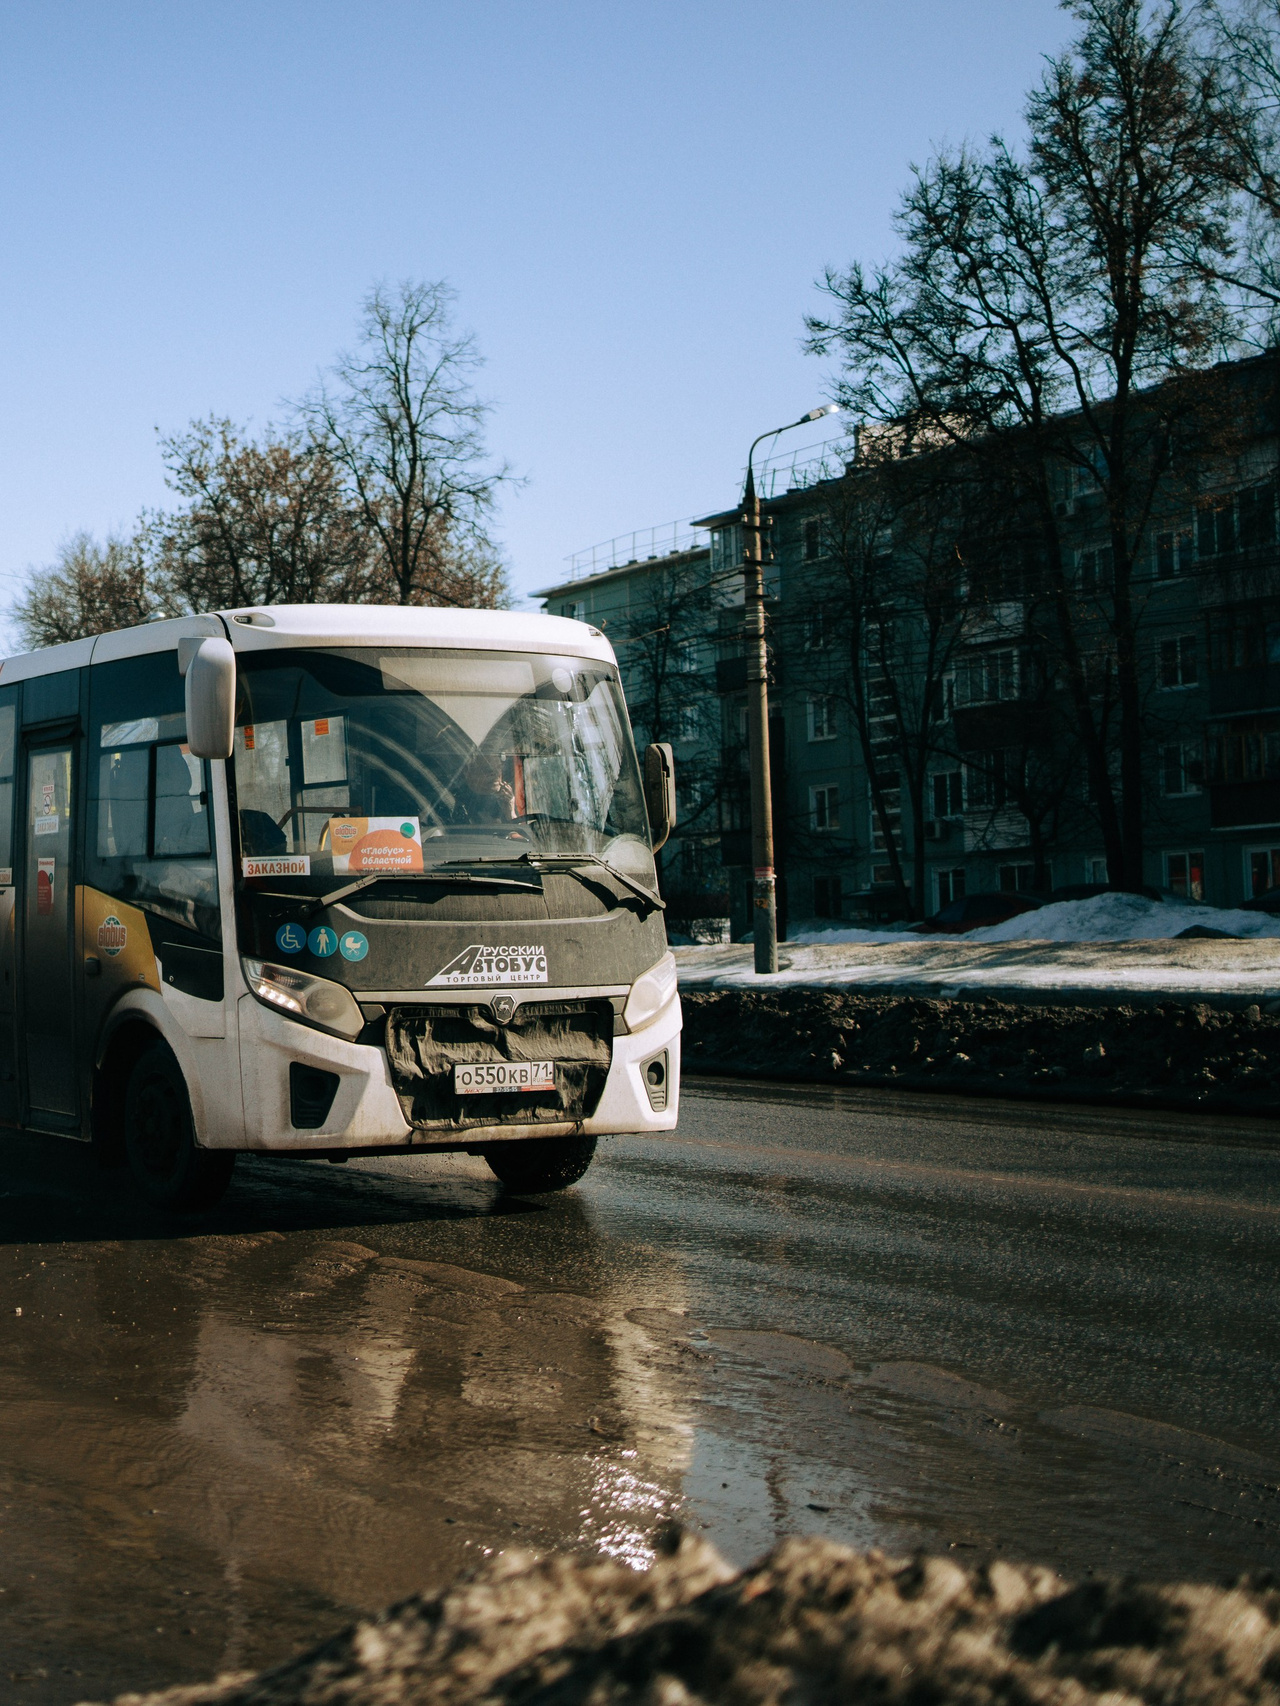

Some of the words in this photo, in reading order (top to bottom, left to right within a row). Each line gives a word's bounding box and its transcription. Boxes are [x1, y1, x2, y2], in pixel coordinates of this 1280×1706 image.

[360, 846, 405, 857] «Глобус»
[361, 855, 412, 865] Областной
[247, 859, 306, 875] ЗАКАЗНОЙ
[439, 946, 547, 975] АВТОБУС
[446, 974, 501, 983] ТОРГОВЫЙ
[510, 974, 541, 982] ЦЕНТР
[461, 1066, 529, 1086] О550КВ
[532, 1063, 549, 1078] 71
